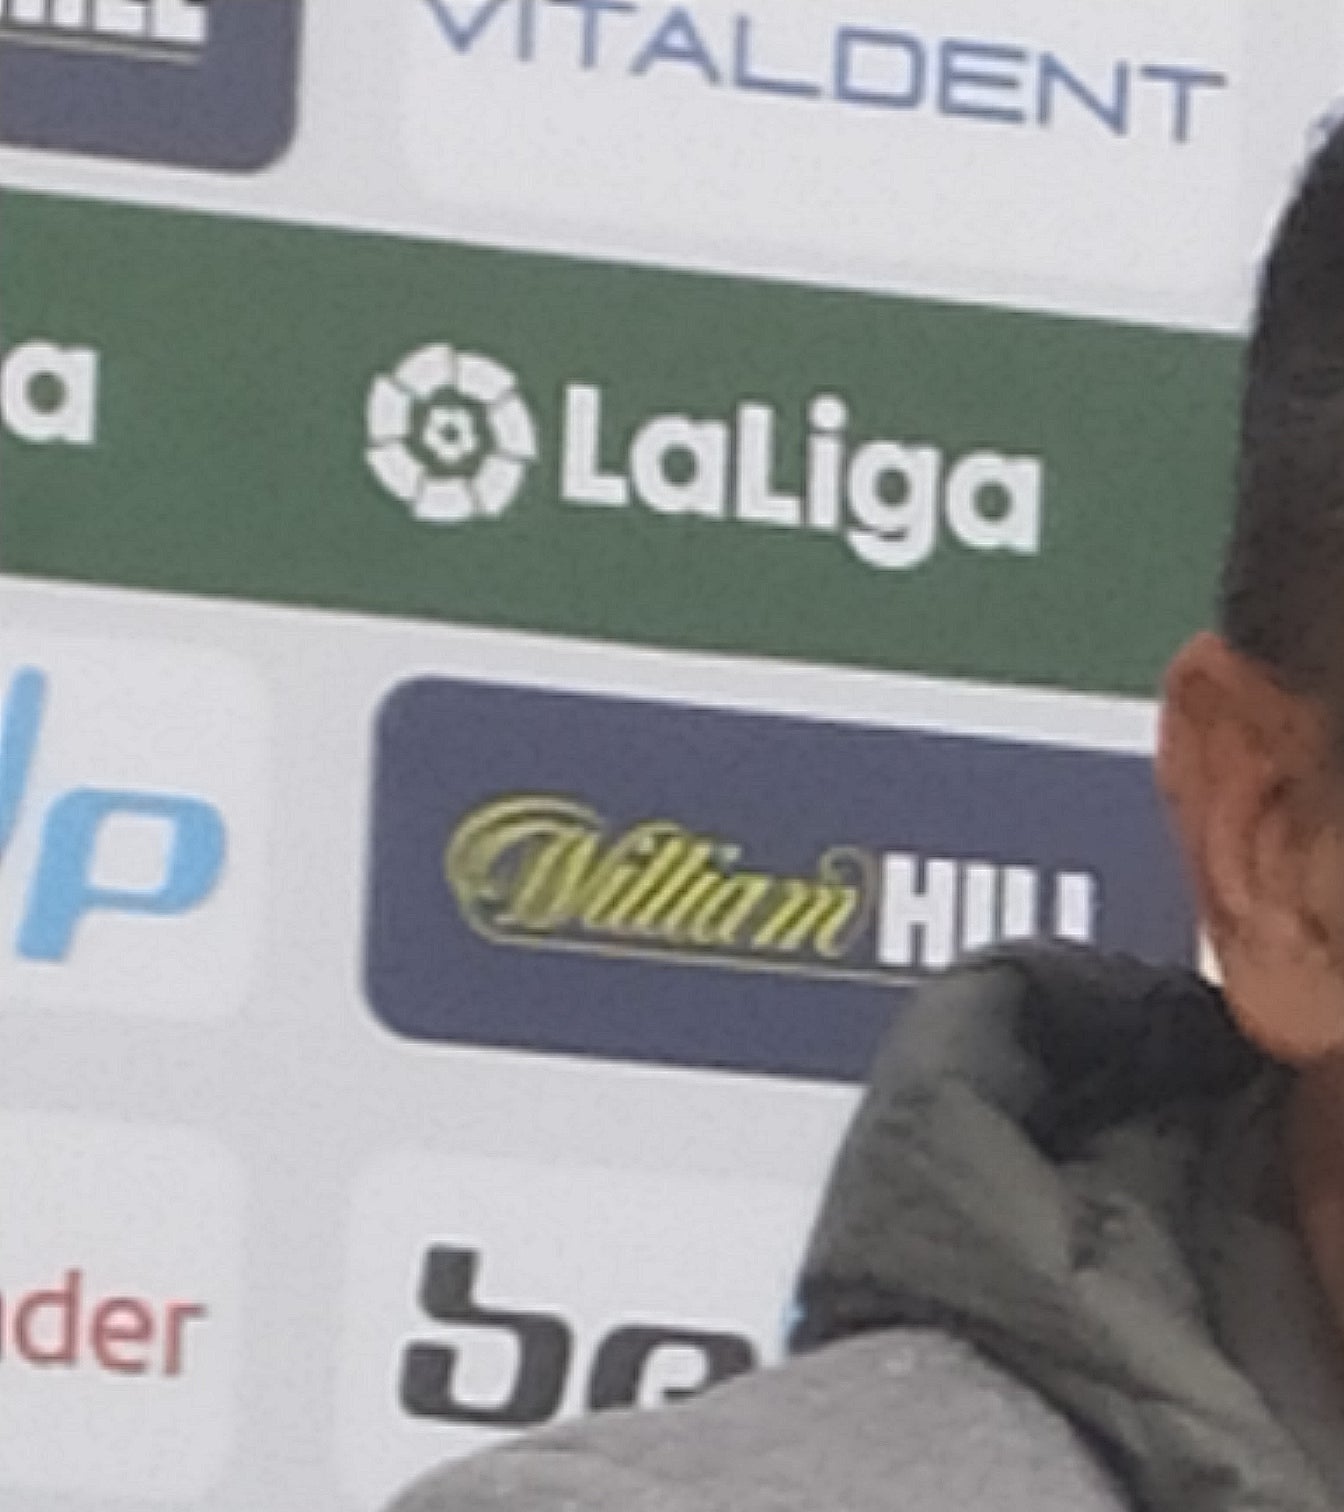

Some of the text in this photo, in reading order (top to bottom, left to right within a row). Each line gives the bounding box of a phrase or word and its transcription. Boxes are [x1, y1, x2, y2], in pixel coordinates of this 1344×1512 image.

[428, 0, 1226, 143] VITALDENT
[561, 382, 1044, 570] LaLiga
[446, 794, 876, 958] William
[0, 1268, 207, 1378] der
